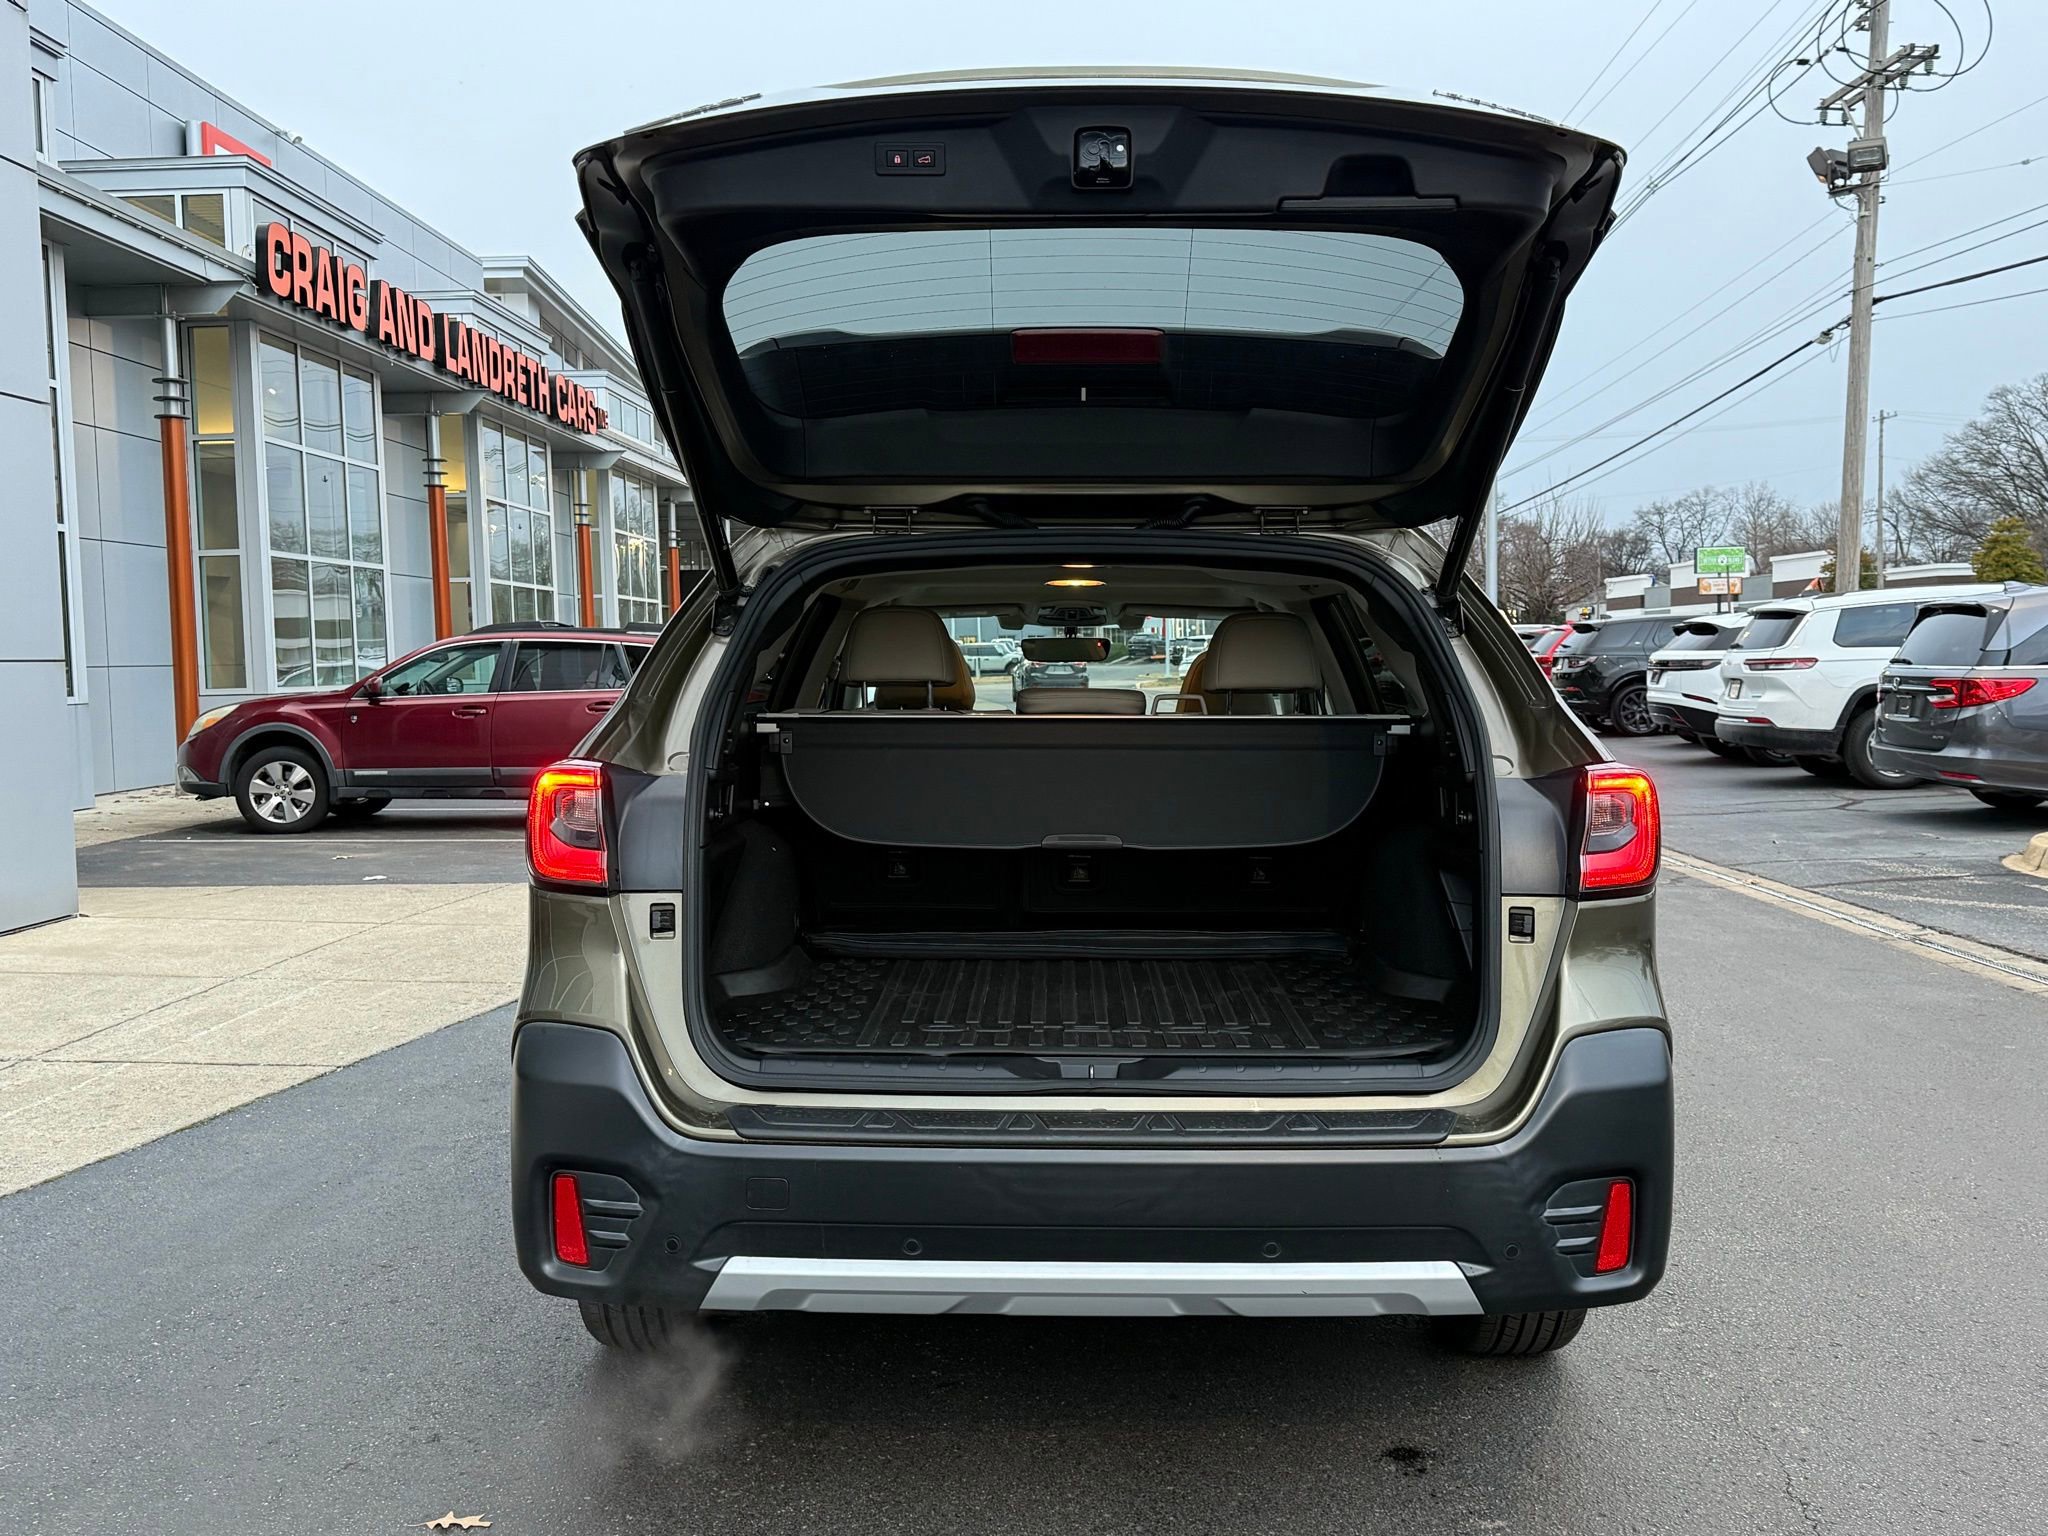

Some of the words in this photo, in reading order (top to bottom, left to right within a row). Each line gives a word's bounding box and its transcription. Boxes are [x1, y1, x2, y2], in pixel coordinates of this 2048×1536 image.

[265, 222, 367, 332] CRAIG
[378, 280, 436, 361] AND
[443, 313, 551, 416] LANDRETH
[555, 373, 598, 436] CARS
